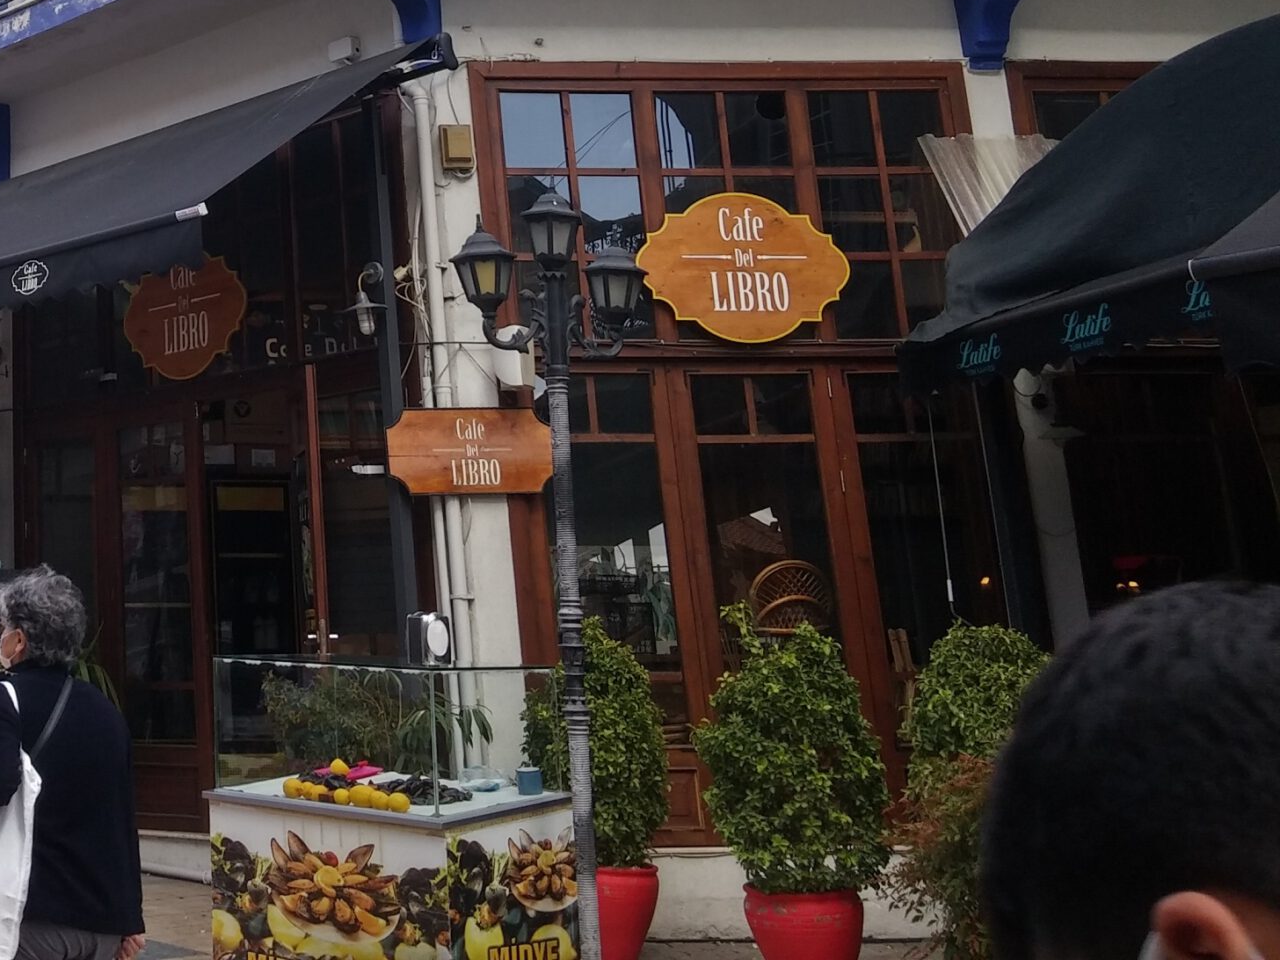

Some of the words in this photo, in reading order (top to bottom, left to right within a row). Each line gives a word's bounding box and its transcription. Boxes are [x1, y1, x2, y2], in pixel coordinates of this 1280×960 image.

[718, 207, 764, 242] Cafe
[734, 248, 754, 268] Del
[710, 271, 790, 312] LIBRO
[164, 310, 209, 356] LIBRO
[1061, 303, 1111, 344] Latife
[957, 333, 1002, 370] Latife
[456, 418, 485, 441] Cafe
[466, 444, 479, 457] Del
[451, 458, 501, 486] LIBRO
[488, 937, 559, 960] MİDYE
